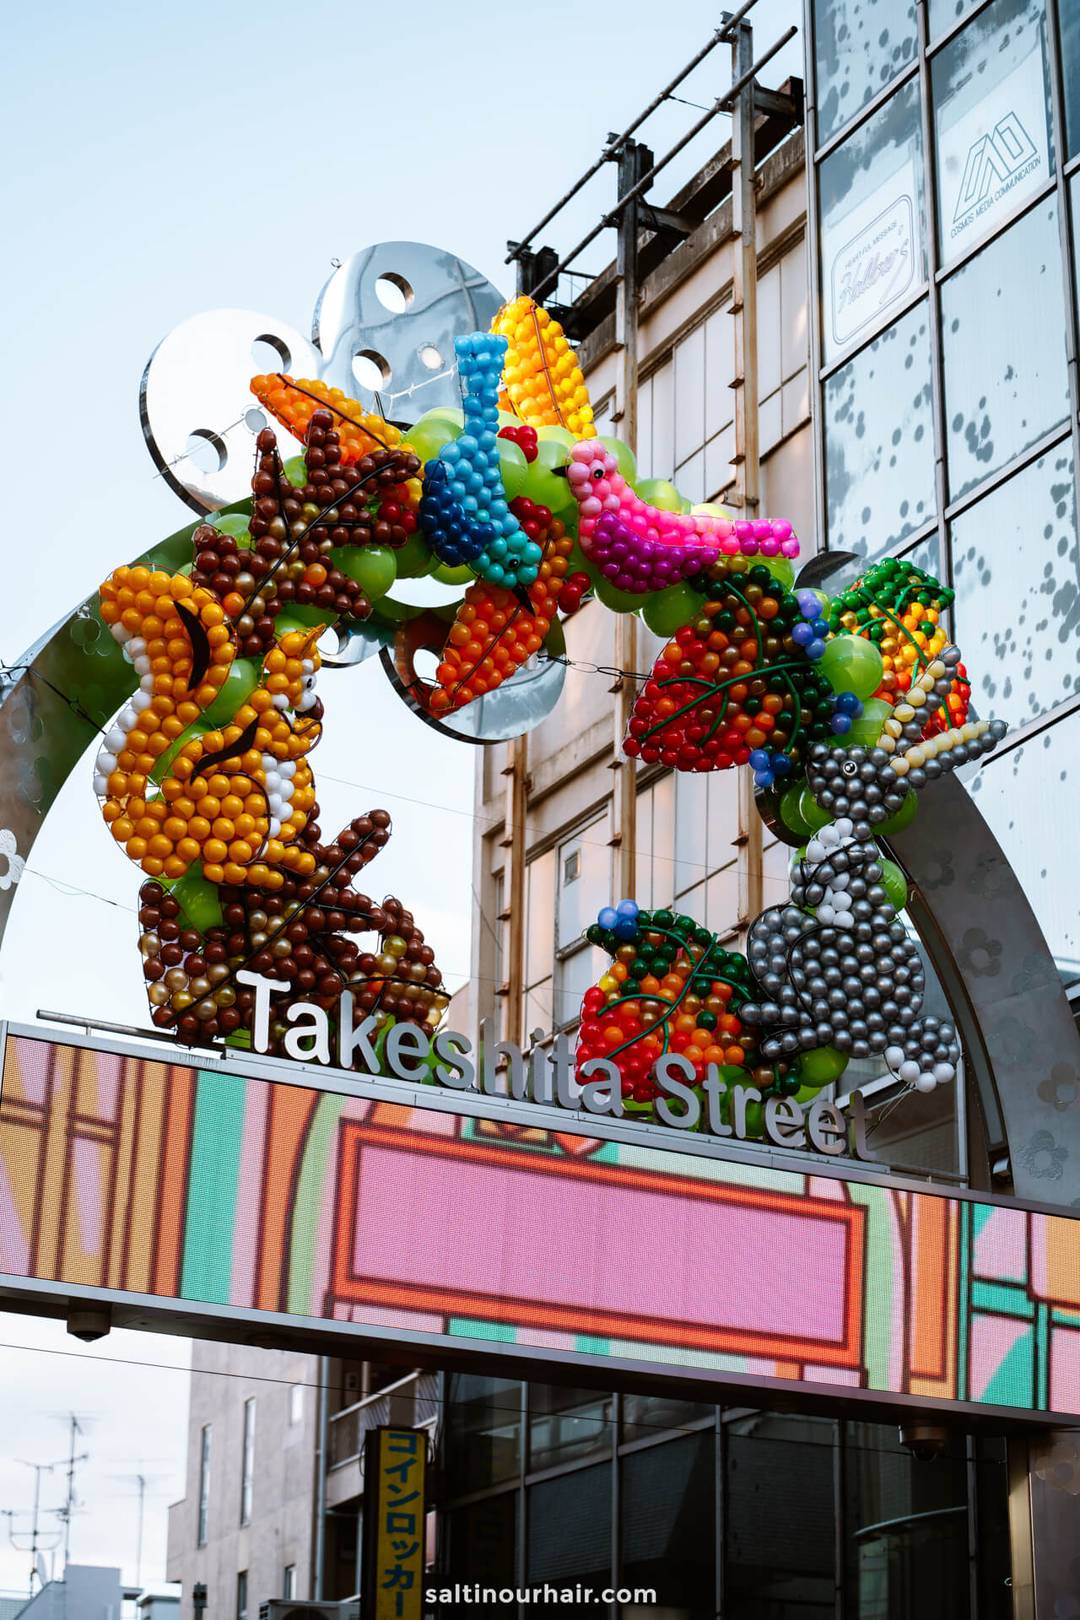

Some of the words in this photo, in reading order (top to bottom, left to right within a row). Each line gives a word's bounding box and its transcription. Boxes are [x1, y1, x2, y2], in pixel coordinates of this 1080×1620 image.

[950, 213, 975, 239] COSMOS
[975, 197, 994, 218] MEDIA
[994, 156, 1042, 202] COMMUNICATION
[235, 969, 625, 1118] Takeshita
[654, 1052, 877, 1161] Street
[383, 1431, 421, 1618] コインロッカー
